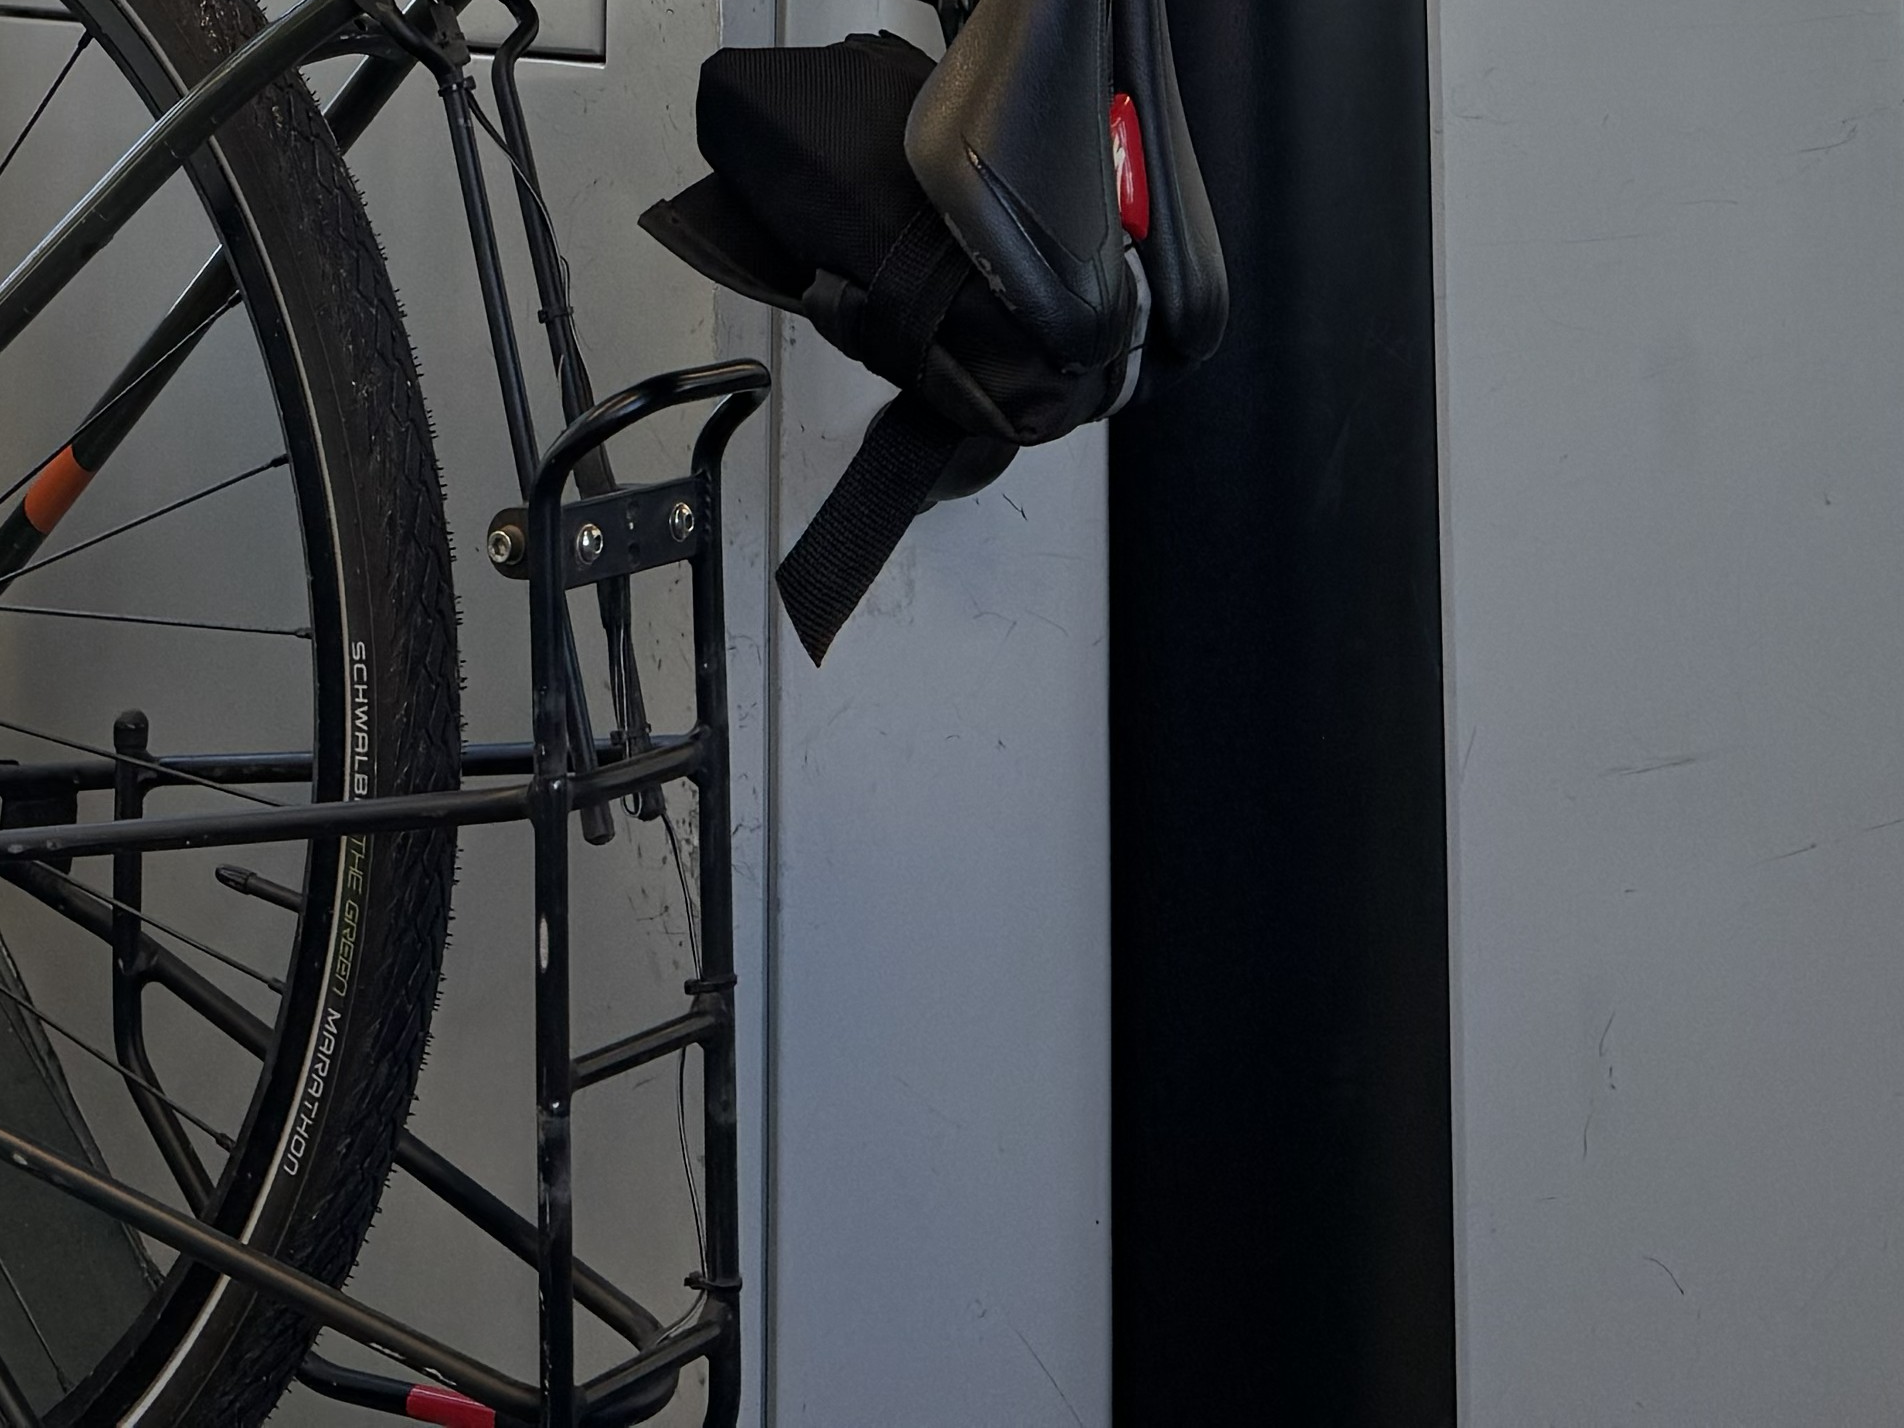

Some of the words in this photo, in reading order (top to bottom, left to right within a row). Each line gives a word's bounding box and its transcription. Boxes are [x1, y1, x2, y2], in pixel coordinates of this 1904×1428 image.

[344, 836, 372, 903] THE
[326, 901, 362, 1000] GREEN
[282, 1005, 344, 1180] MARATHON
